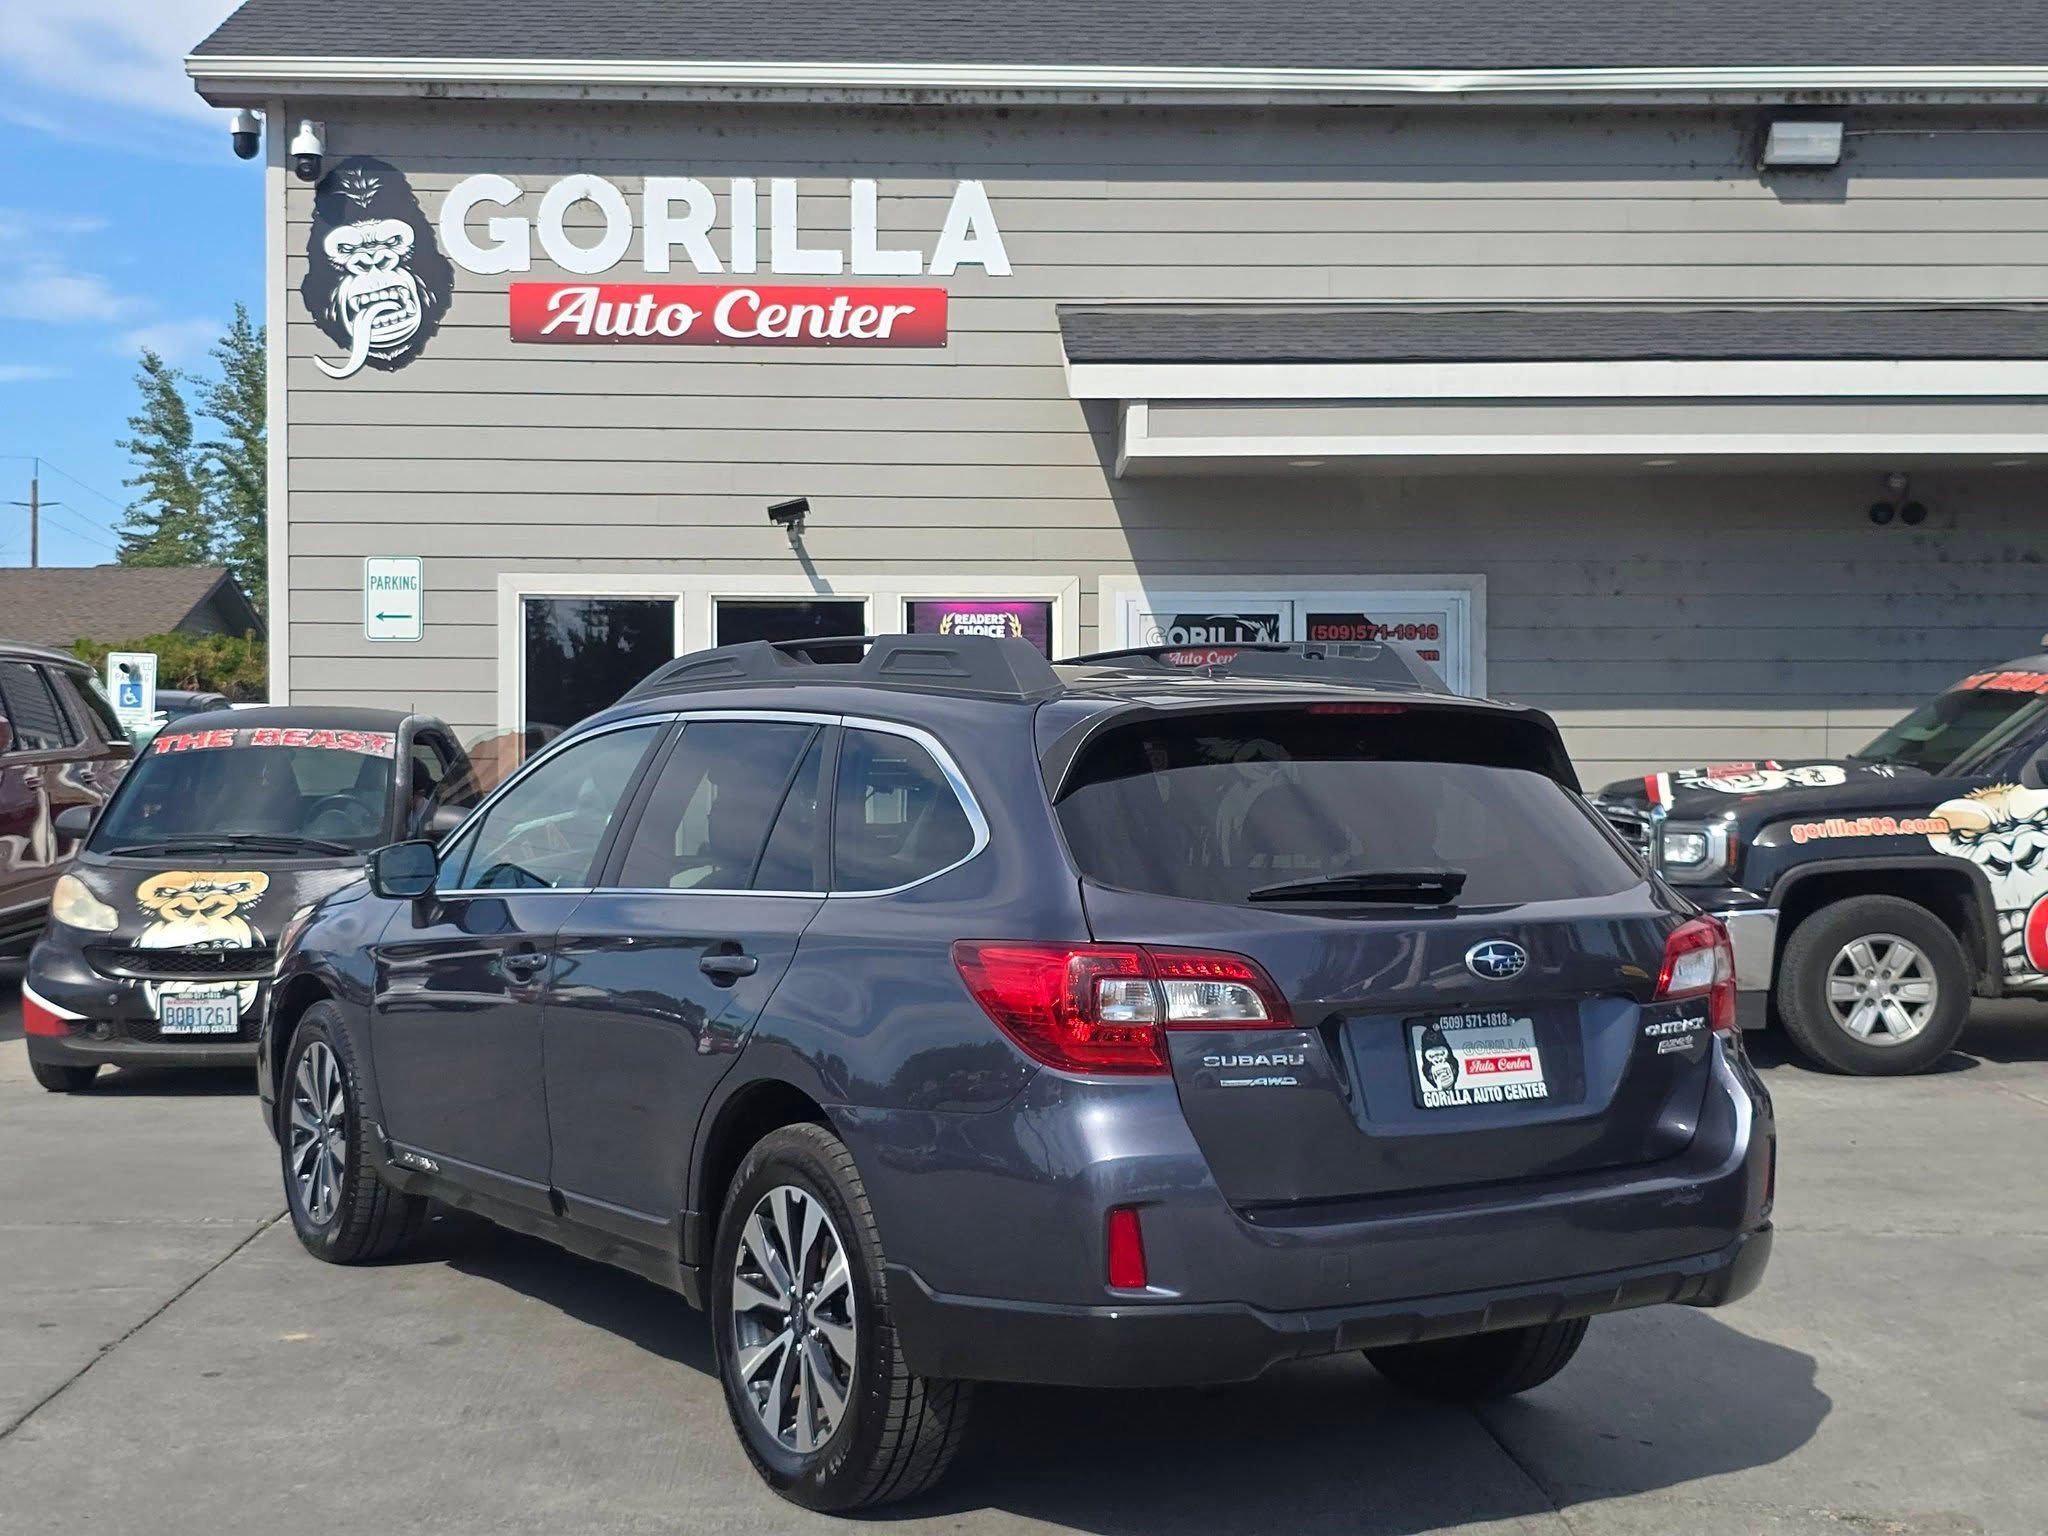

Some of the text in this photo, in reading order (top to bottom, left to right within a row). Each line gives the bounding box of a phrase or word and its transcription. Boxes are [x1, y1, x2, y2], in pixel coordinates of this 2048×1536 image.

[440, 173, 1014, 277] GORILLA
[541, 286, 916, 340] Auto Center
[369, 575, 418, 591] PARKING
[954, 625, 1006, 639] CHOICE
[1146, 626, 1271, 647] GORILLA
[1169, 652, 1203, 666] Auto
[152, 727, 396, 754] THE BEAST
[1790, 816, 1950, 844] gorilla509.com
[1440, 1012, 1508, 1030] (509) 571-1818
[1462, 1037, 1530, 1055] GORILLA
[1203, 1053, 1304, 1067] SUBARU
[1469, 1057, 1532, 1073] Auto Center
[1473, 1085, 1503, 1103] AUTO
[1503, 1081, 1548, 1101] CENTER
